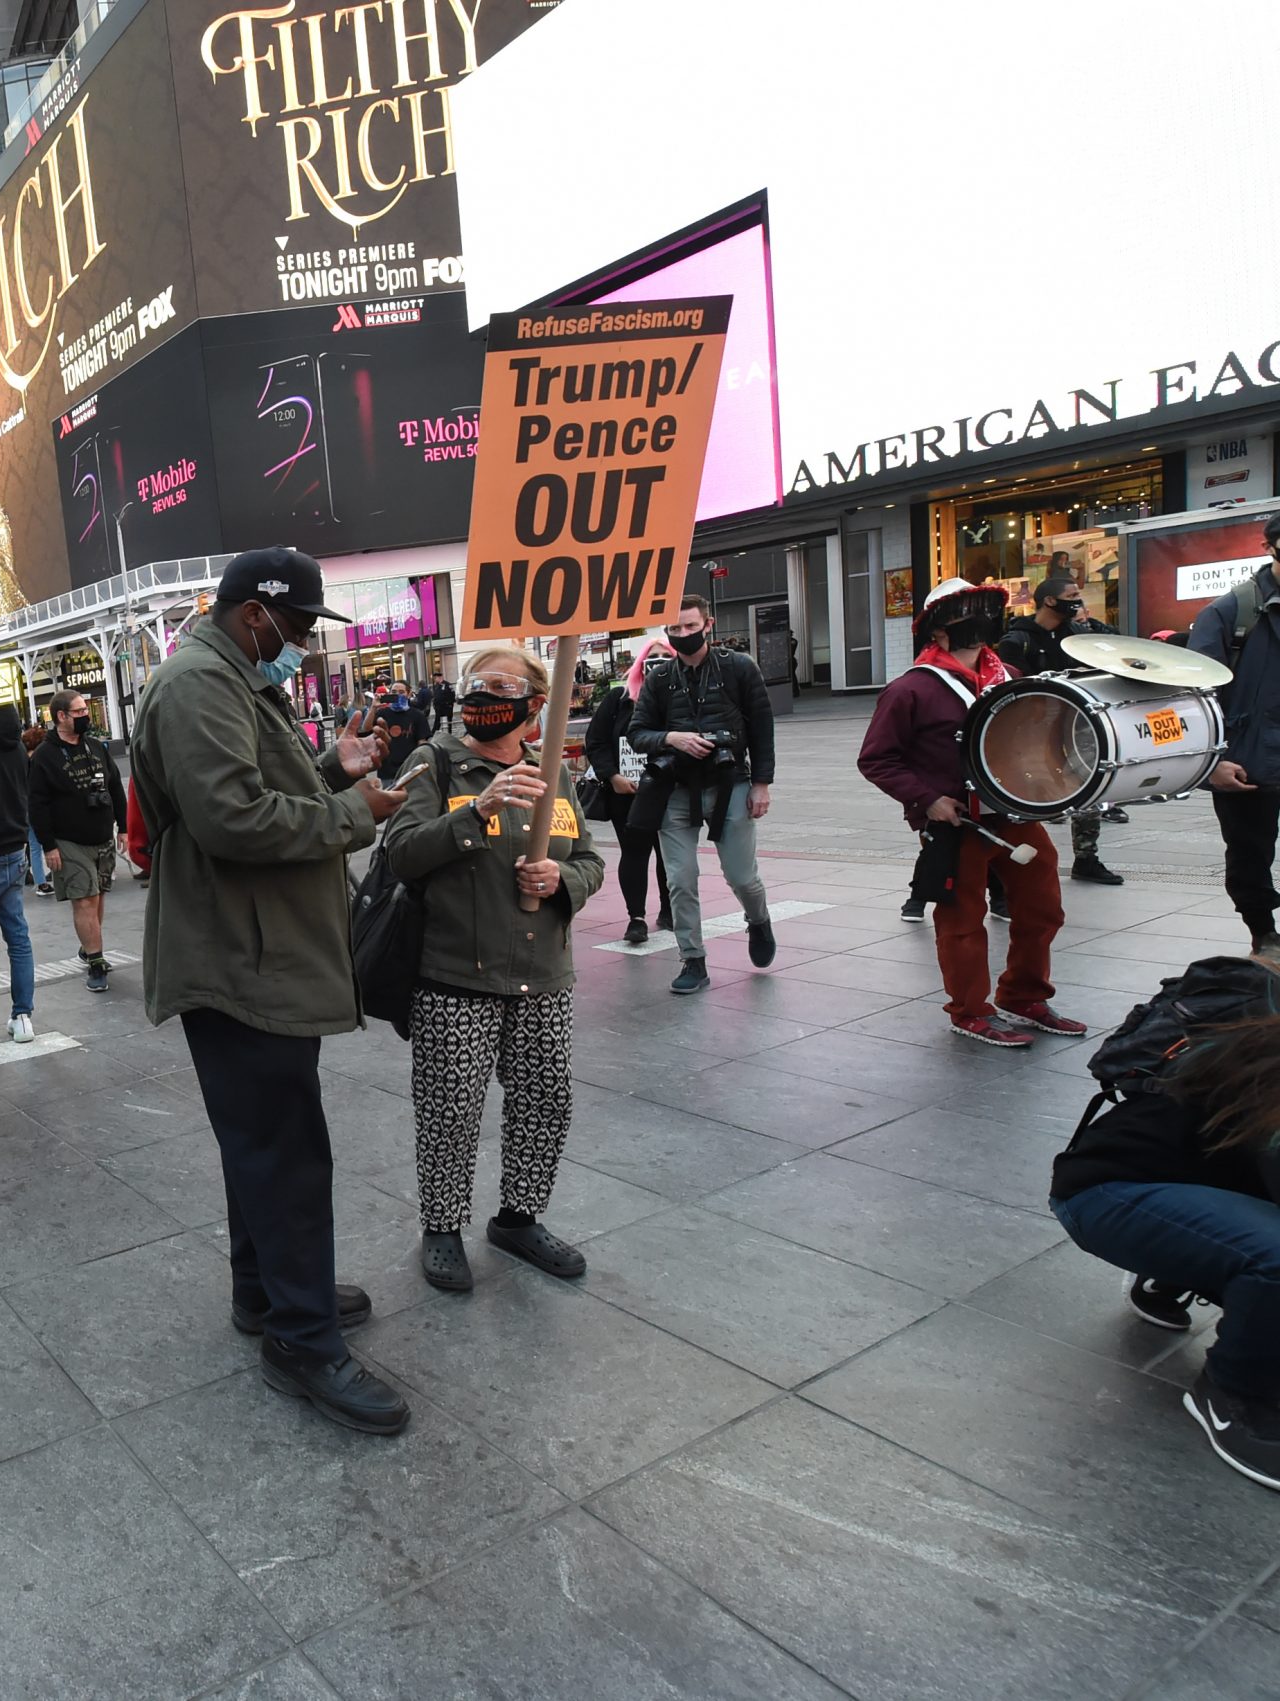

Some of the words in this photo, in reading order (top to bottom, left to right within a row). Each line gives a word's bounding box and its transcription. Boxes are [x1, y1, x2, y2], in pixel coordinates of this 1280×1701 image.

[201, 0, 481, 137] FILTHY
[42, 58, 81, 116] MARRIOTT
[43, 81, 78, 130] MARQUIS
[276, 85, 457, 241] RICH
[276, 251, 332, 272] SERIES
[338, 242, 416, 266] PREMIERE
[278, 265, 369, 302] TONIGHT
[374, 263, 419, 296] 9pm
[365, 299, 425, 314] MARRIOTT
[366, 310, 420, 325] MARQUIS
[59, 339, 87, 368] SERIES
[89, 297, 133, 341] PREMIERE
[517, 308, 704, 339] RefuseFascism.org
[61, 337, 109, 395] TONIGHT
[110, 325, 137, 361] 9pm
[137, 285, 176, 340] FOX
[509, 342, 704, 408] Trump/
[72, 395, 98, 418] MARRIOTT
[73, 407, 98, 428] MARQUIS
[273, 408, 296, 422] 12:00
[422, 413, 482, 445] Mobi
[515, 414, 677, 464] Pence
[788, 379, 1123, 495] AMERICAN
[424, 445, 466, 463] REVVL
[1220, 439, 1248, 461] NBA
[150, 458, 197, 497] Mobile
[152, 495, 175, 514] REVVL
[176, 488, 187, 503] 5G
[515, 465, 667, 547] OUT
[474, 546, 675, 630] NOW!
[1192, 584, 1201, 592] IF
[1206, 581, 1226, 590] YOU
[1193, 567, 1235, 581] DON'T
[67, 669, 106, 688] SEPHORA
[481, 711, 515, 726] NOW
[1135, 716, 1189, 739] YAA
[1153, 716, 1176, 732] OUT
[1154, 727, 1181, 742] NOW
[620, 757, 626, 767] A
